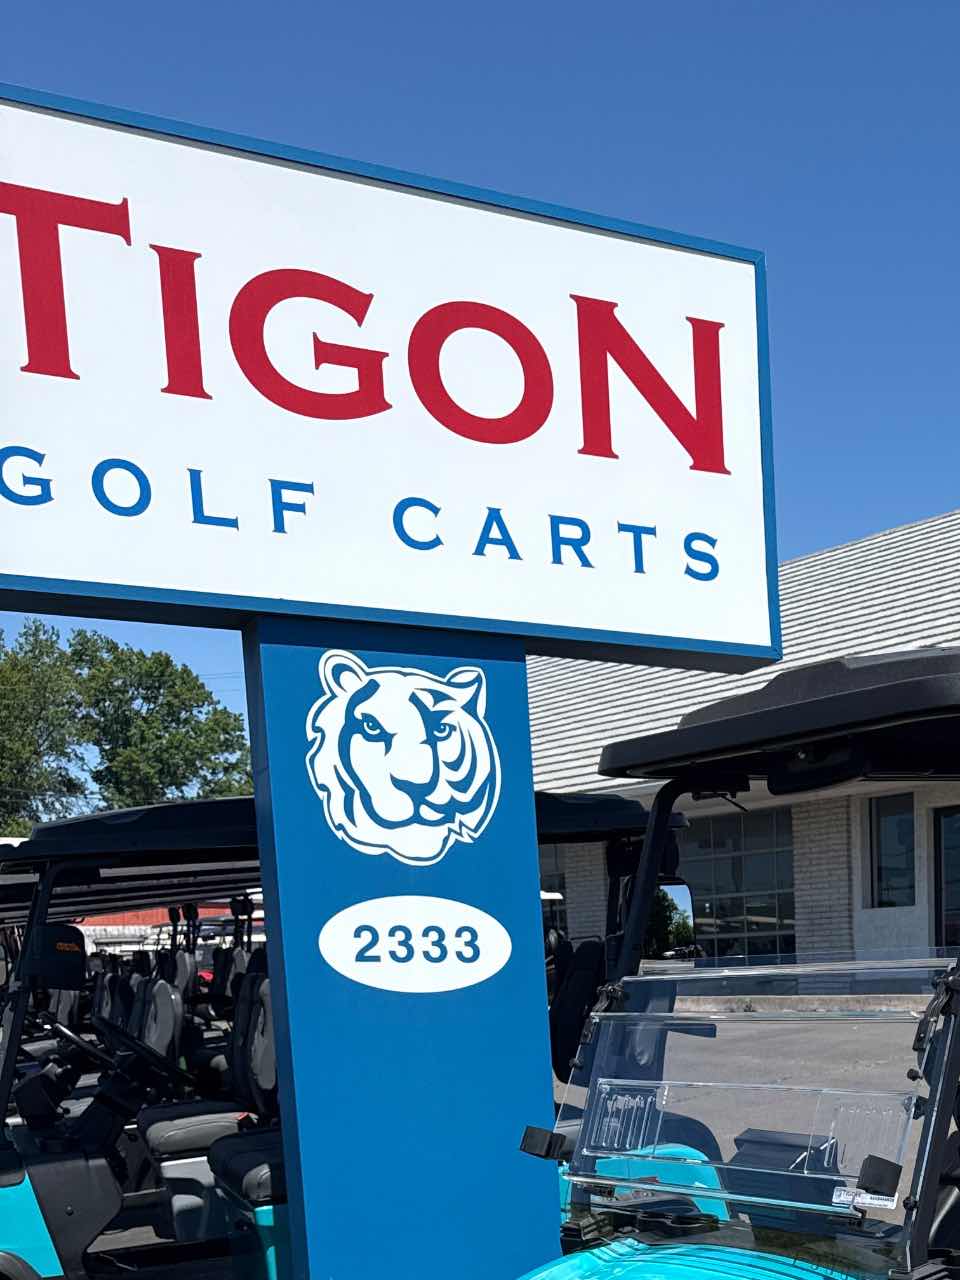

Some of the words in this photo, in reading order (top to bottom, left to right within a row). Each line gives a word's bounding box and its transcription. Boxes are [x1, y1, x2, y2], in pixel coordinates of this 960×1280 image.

[0, 181, 731, 475] TIGON
[0, 445, 315, 533] GOLF
[392, 496, 720, 581] CARTS
[353, 924, 481, 963] 2333
